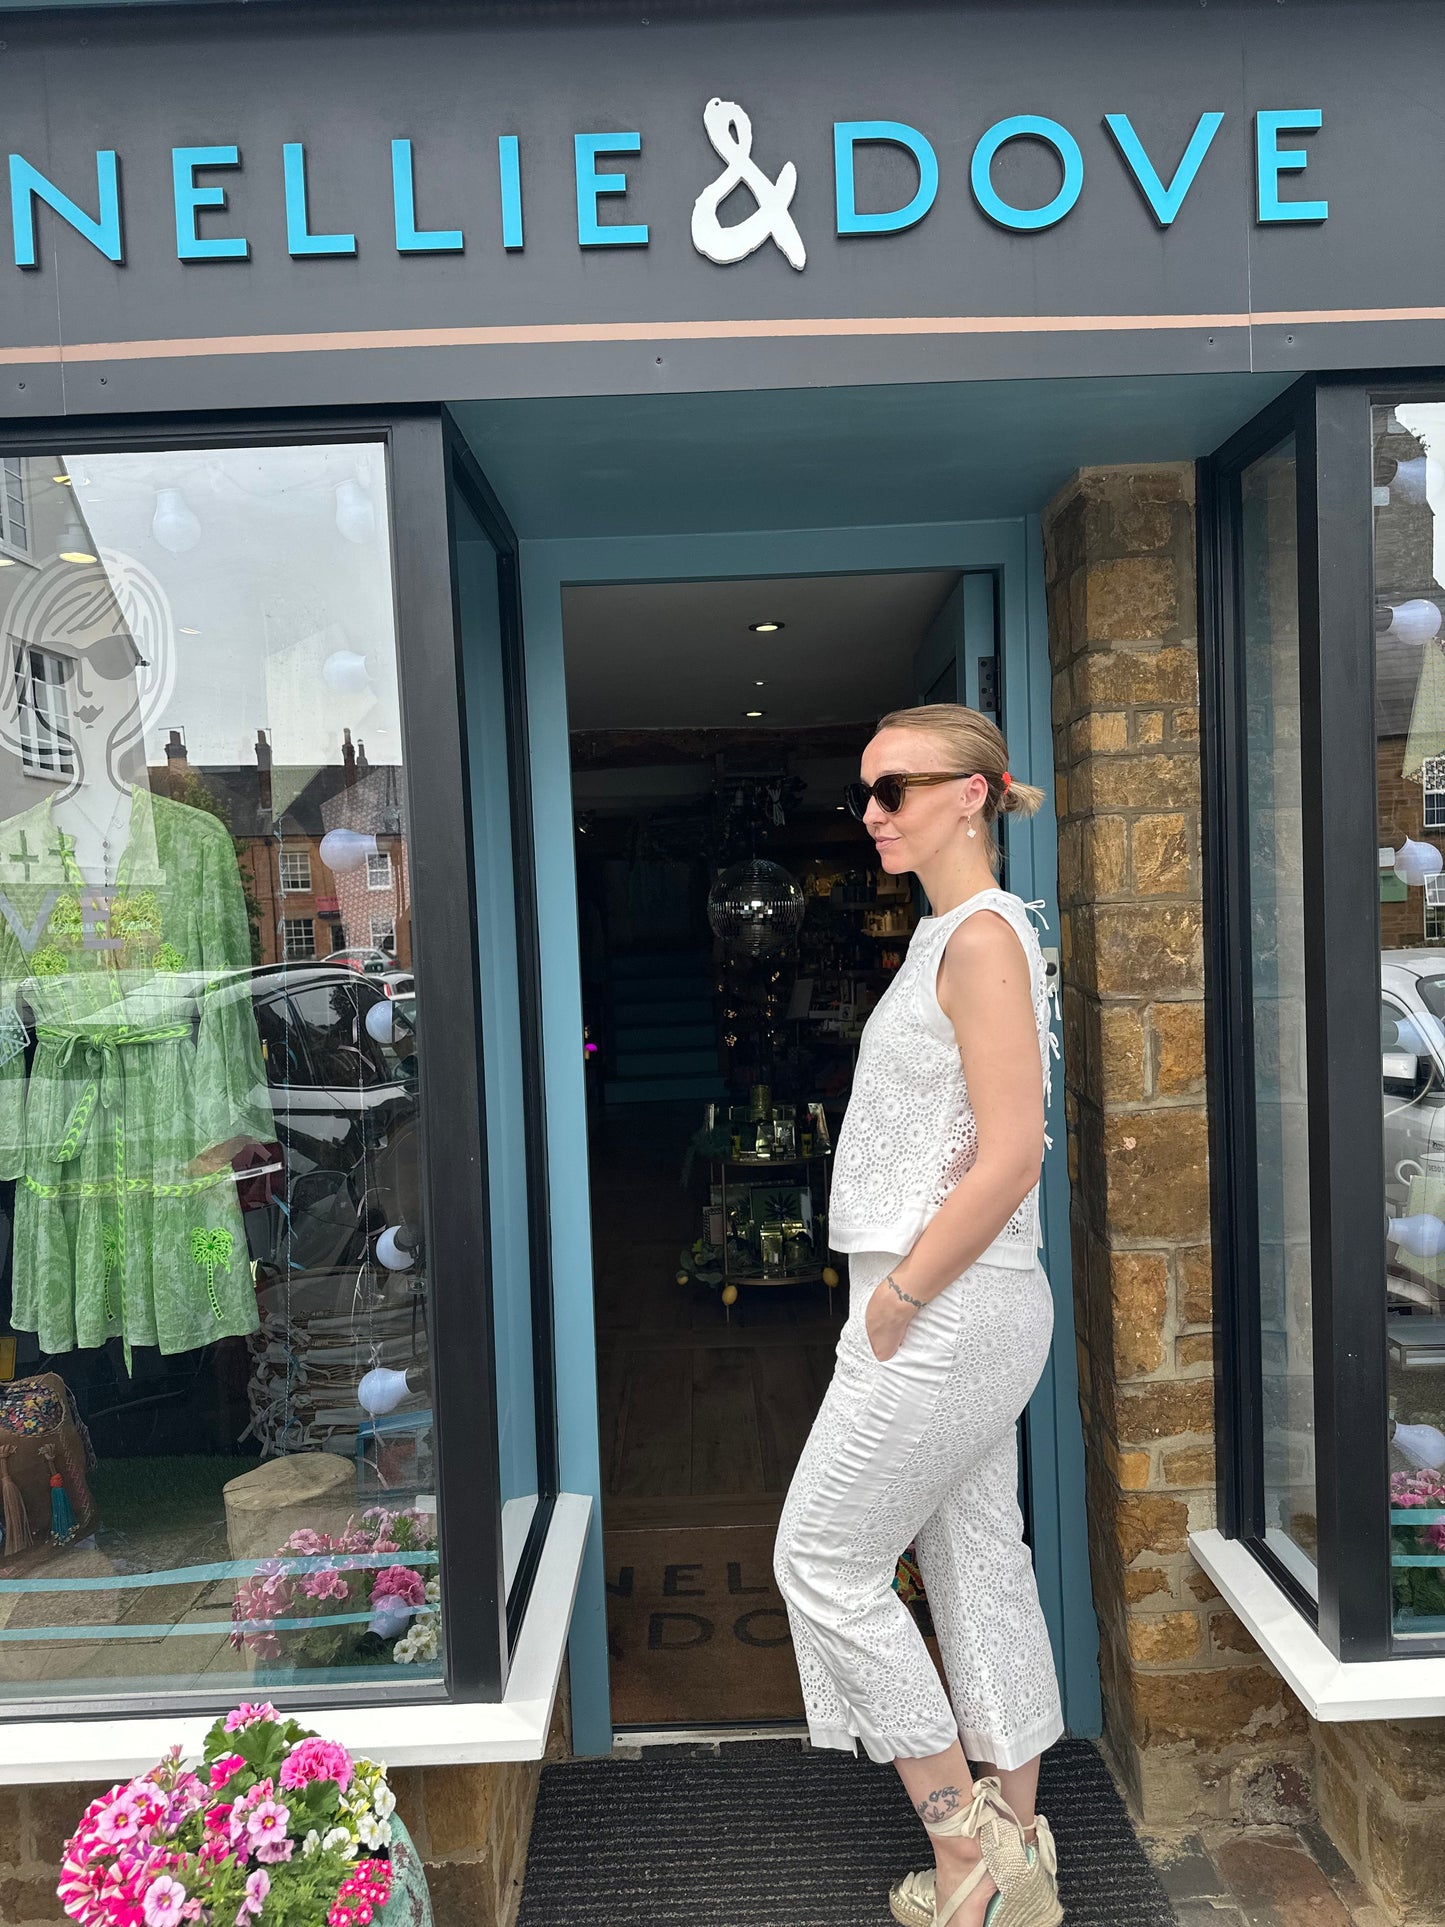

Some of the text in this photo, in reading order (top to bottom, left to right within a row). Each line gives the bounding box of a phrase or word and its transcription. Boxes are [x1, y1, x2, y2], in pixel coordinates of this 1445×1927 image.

[9, 97, 1329, 272] NELLIE & DOVE
